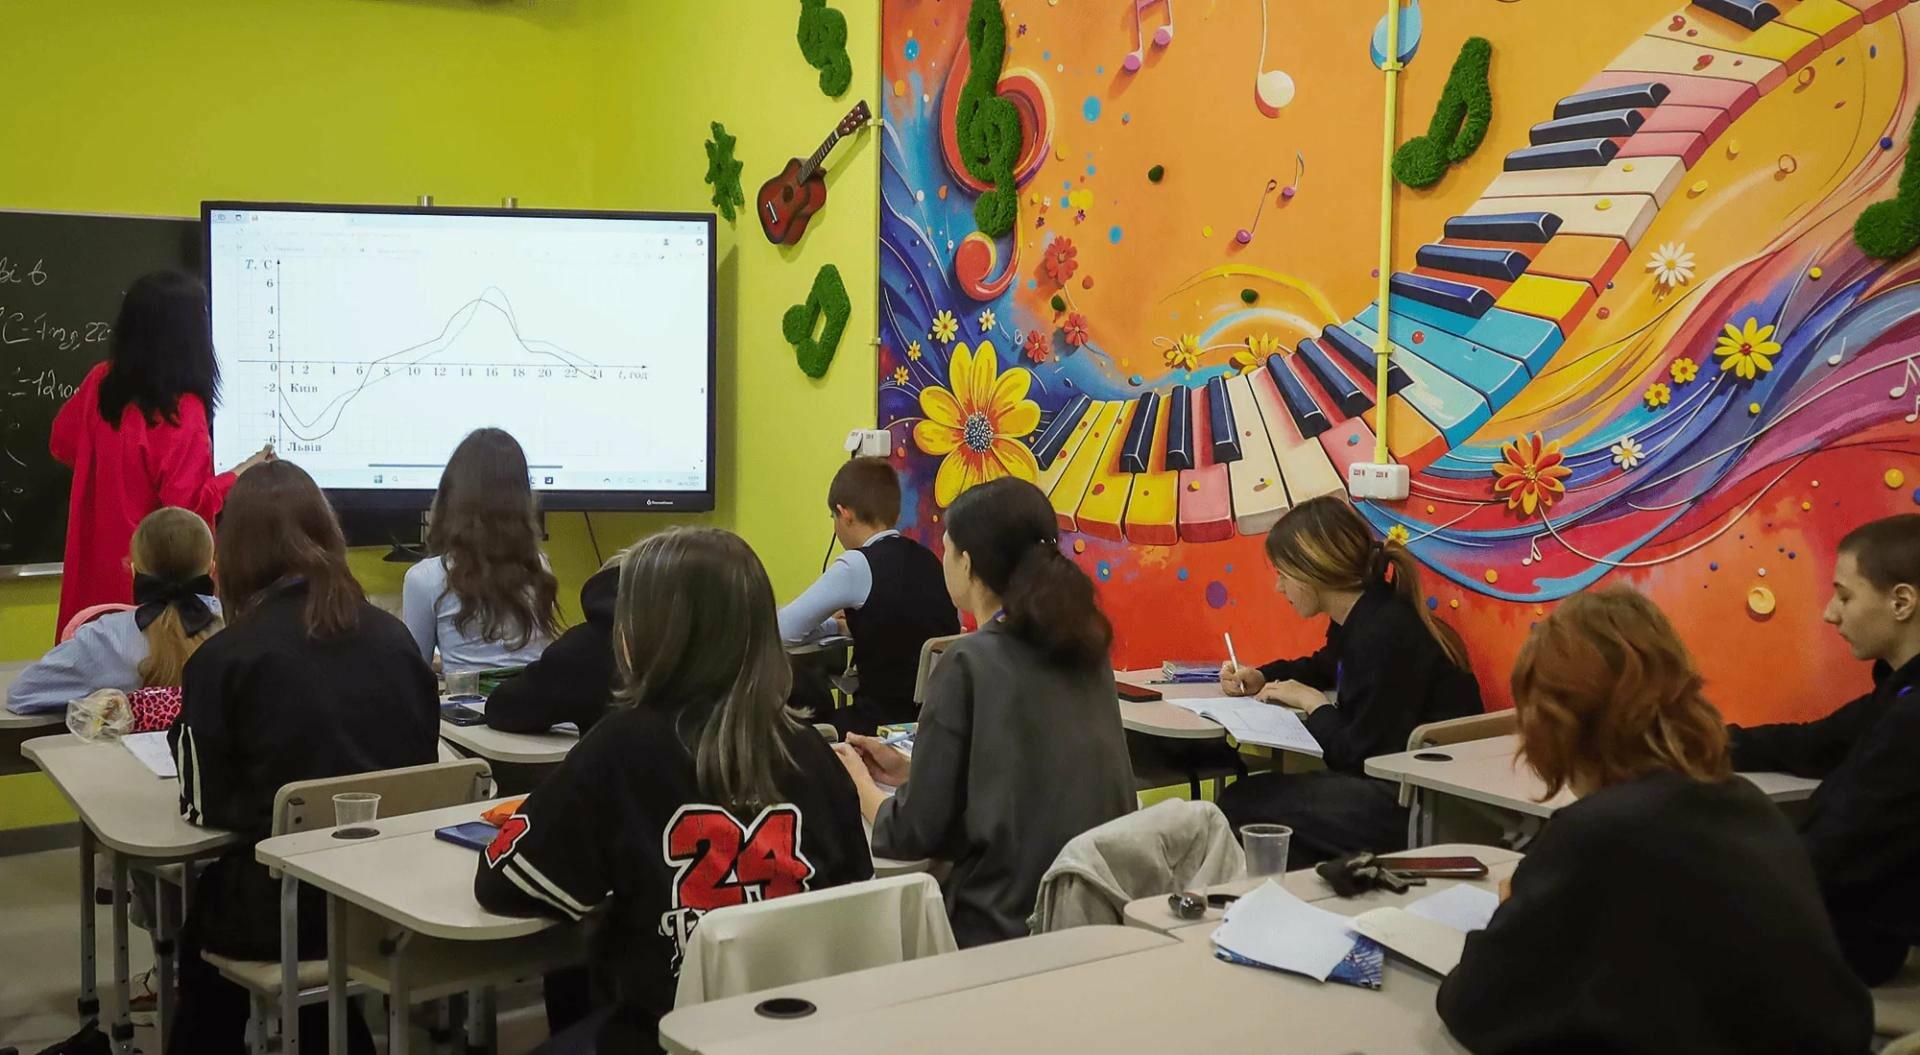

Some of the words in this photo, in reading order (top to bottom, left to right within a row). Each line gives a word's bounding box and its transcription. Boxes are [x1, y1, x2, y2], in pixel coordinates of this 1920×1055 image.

[266, 278, 274, 288] 6
[268, 329, 275, 340] 2
[269, 343, 274, 353] 1
[270, 362, 278, 372] 0
[290, 364, 295, 375] 1
[302, 365, 310, 375] 2
[356, 366, 363, 376] 6
[383, 367, 391, 377] 8
[408, 366, 421, 377] 10
[434, 367, 447, 377] 12
[461, 367, 472, 377] 14
[486, 367, 499, 377] 16
[513, 367, 526, 378] 18
[538, 367, 552, 378] 20
[564, 367, 579, 379] 22
[287, 441, 322, 452] Львів
[662, 803, 815, 911] 24
